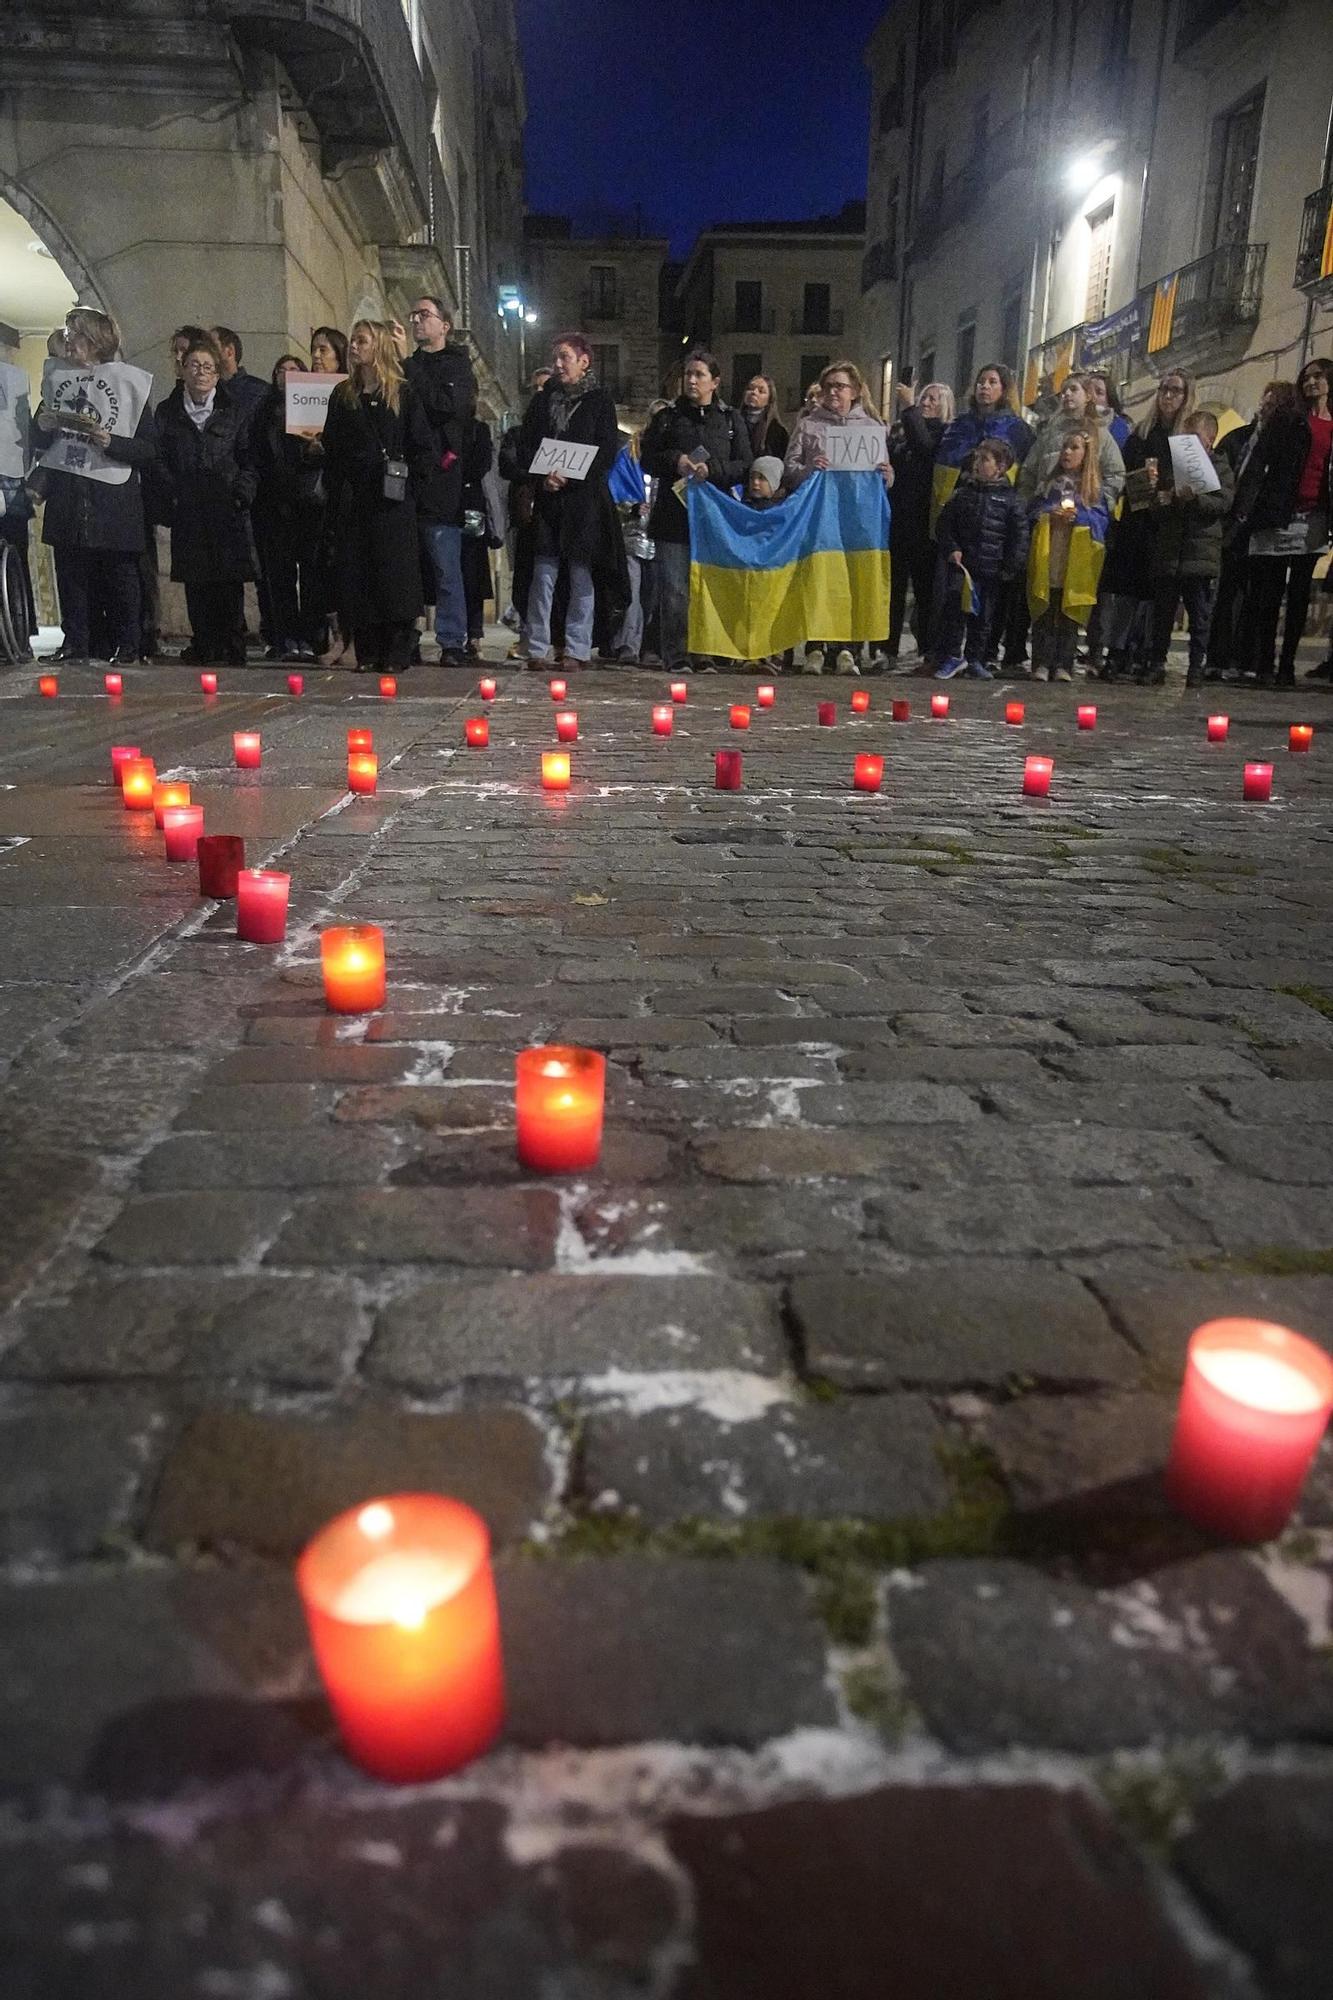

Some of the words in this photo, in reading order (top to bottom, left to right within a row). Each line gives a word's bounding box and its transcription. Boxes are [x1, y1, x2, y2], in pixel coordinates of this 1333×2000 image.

[52, 380, 72, 411] urem
[292, 393, 328, 406] Soma
[534, 446, 589, 471] MALI
[828, 435, 880, 465] TXAD
